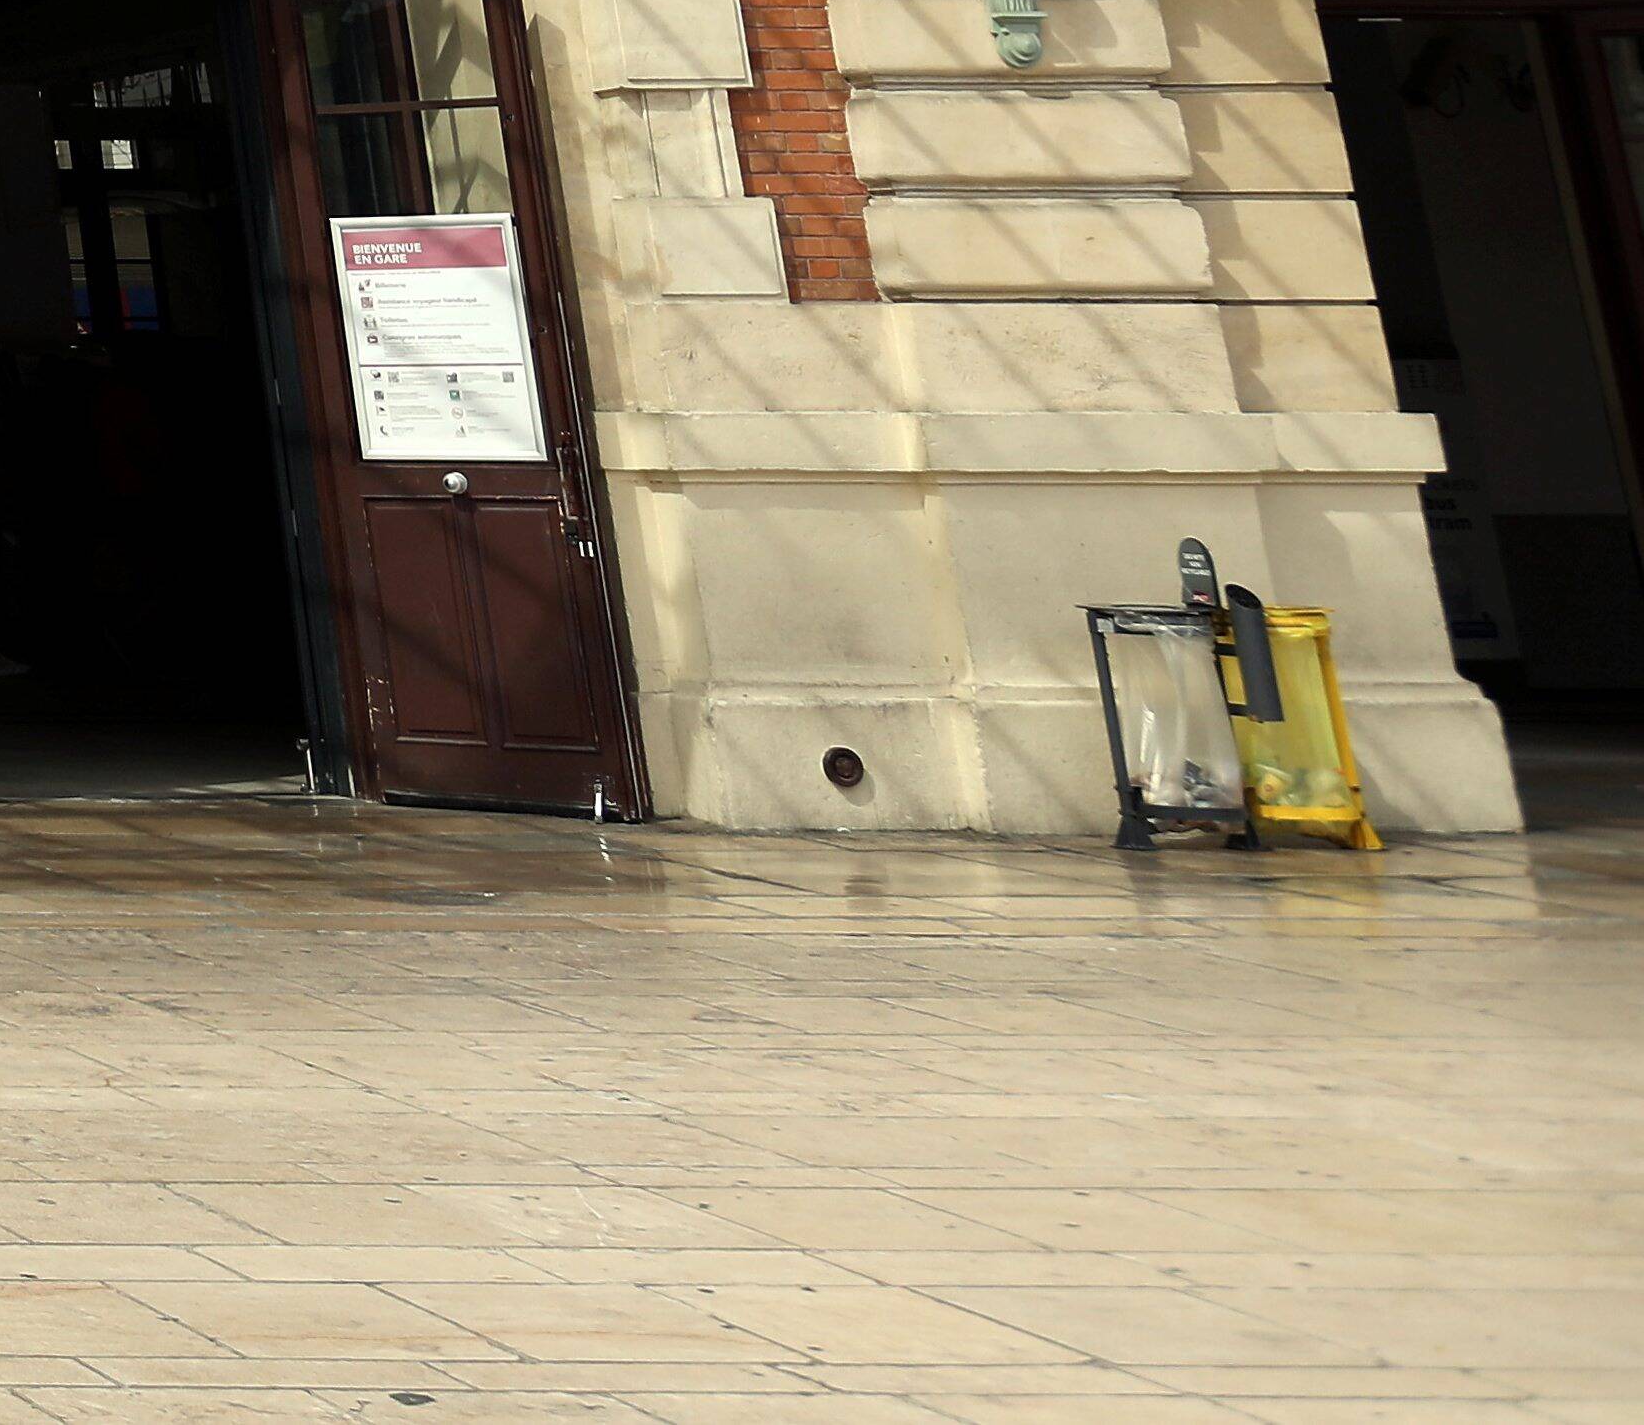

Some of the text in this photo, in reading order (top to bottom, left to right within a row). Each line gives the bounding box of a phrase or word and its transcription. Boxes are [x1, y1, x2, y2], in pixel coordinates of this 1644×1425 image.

[352, 242, 422, 254] BIENVENUE
[354, 253, 408, 264] EN GARE
